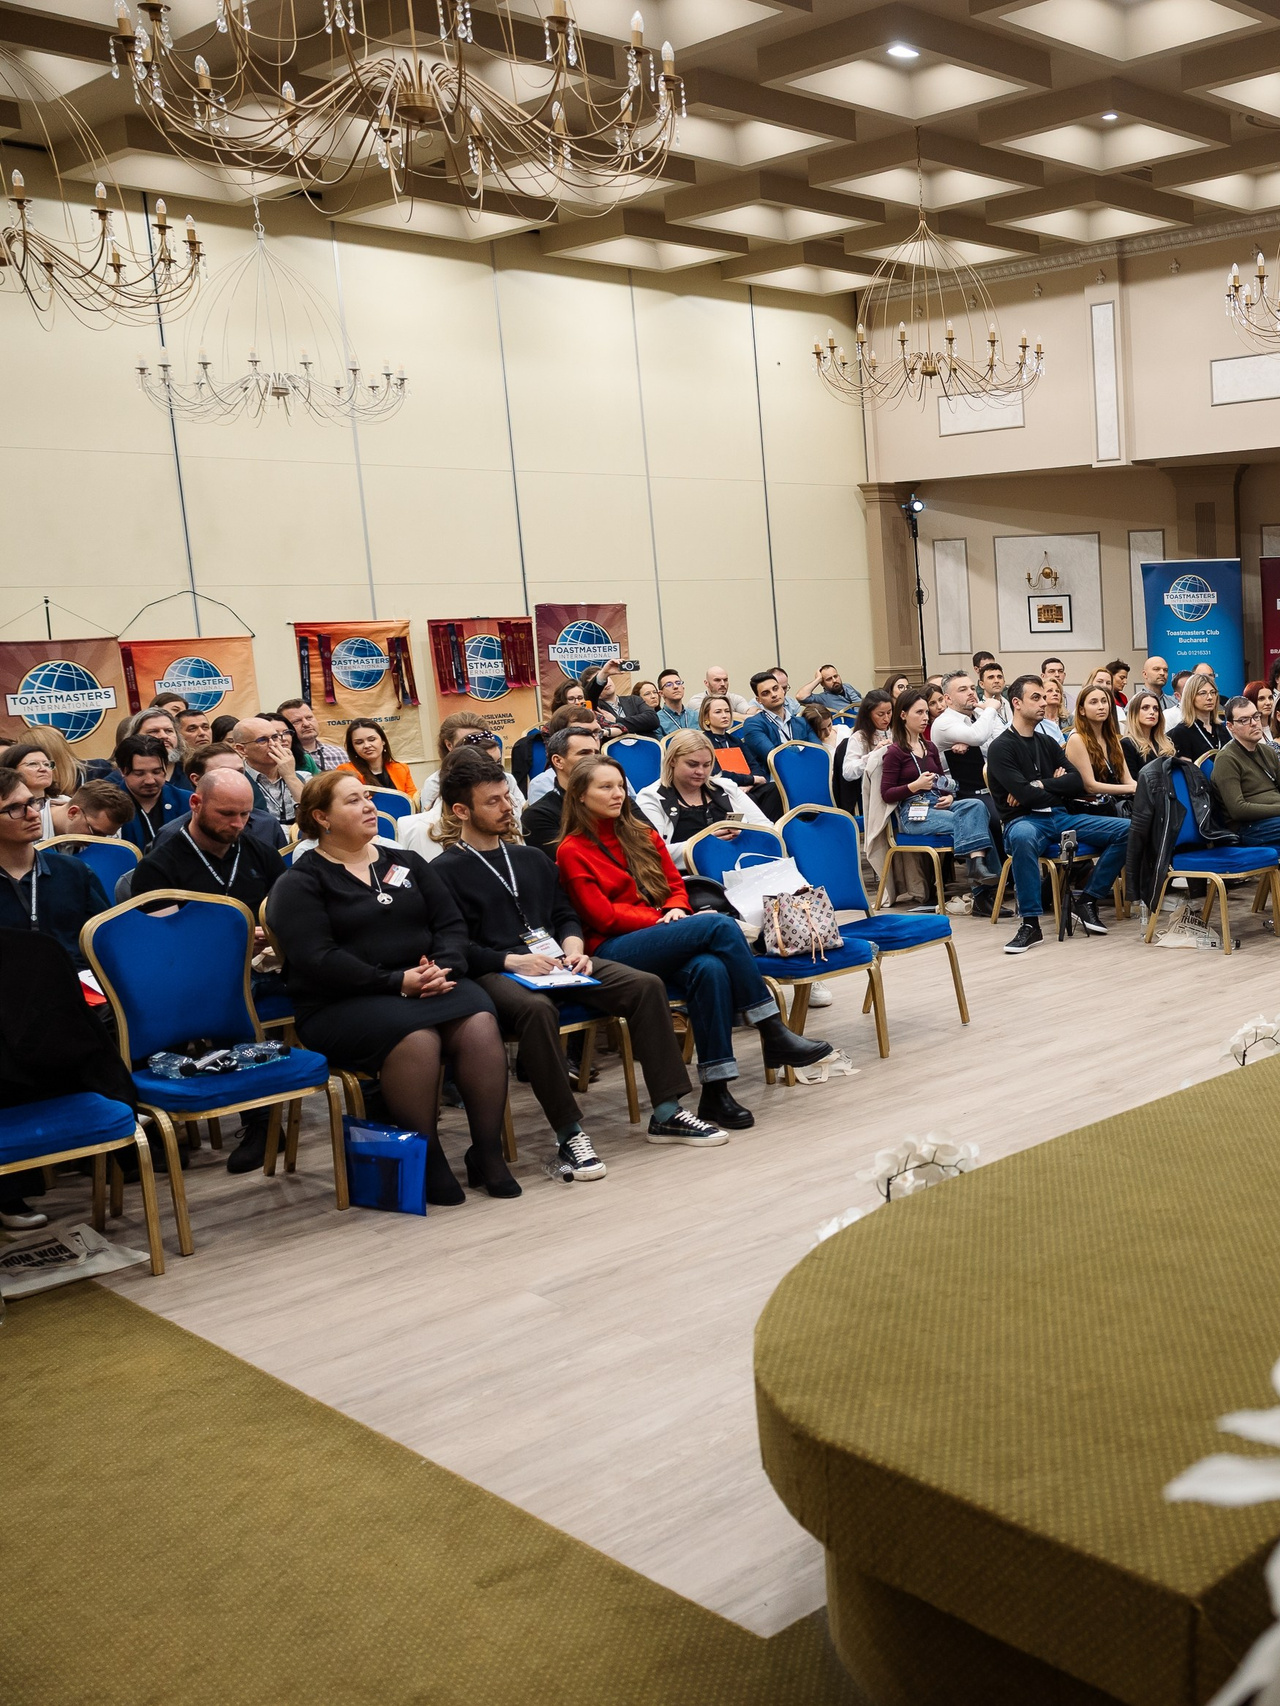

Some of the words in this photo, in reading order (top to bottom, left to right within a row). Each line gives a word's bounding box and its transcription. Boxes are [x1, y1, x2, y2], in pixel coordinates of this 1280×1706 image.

[551, 645, 618, 654] TOASTMASTERS
[331, 658, 390, 666] OASTMASTERS
[468, 661, 504, 670] STMAST
[158, 678, 230, 688] TOASTMASTERS
[10, 690, 112, 706] TOASTMASTERS
[23, 702, 101, 712] INTERNATIONAL
[327, 717, 383, 726] TOASTRS
